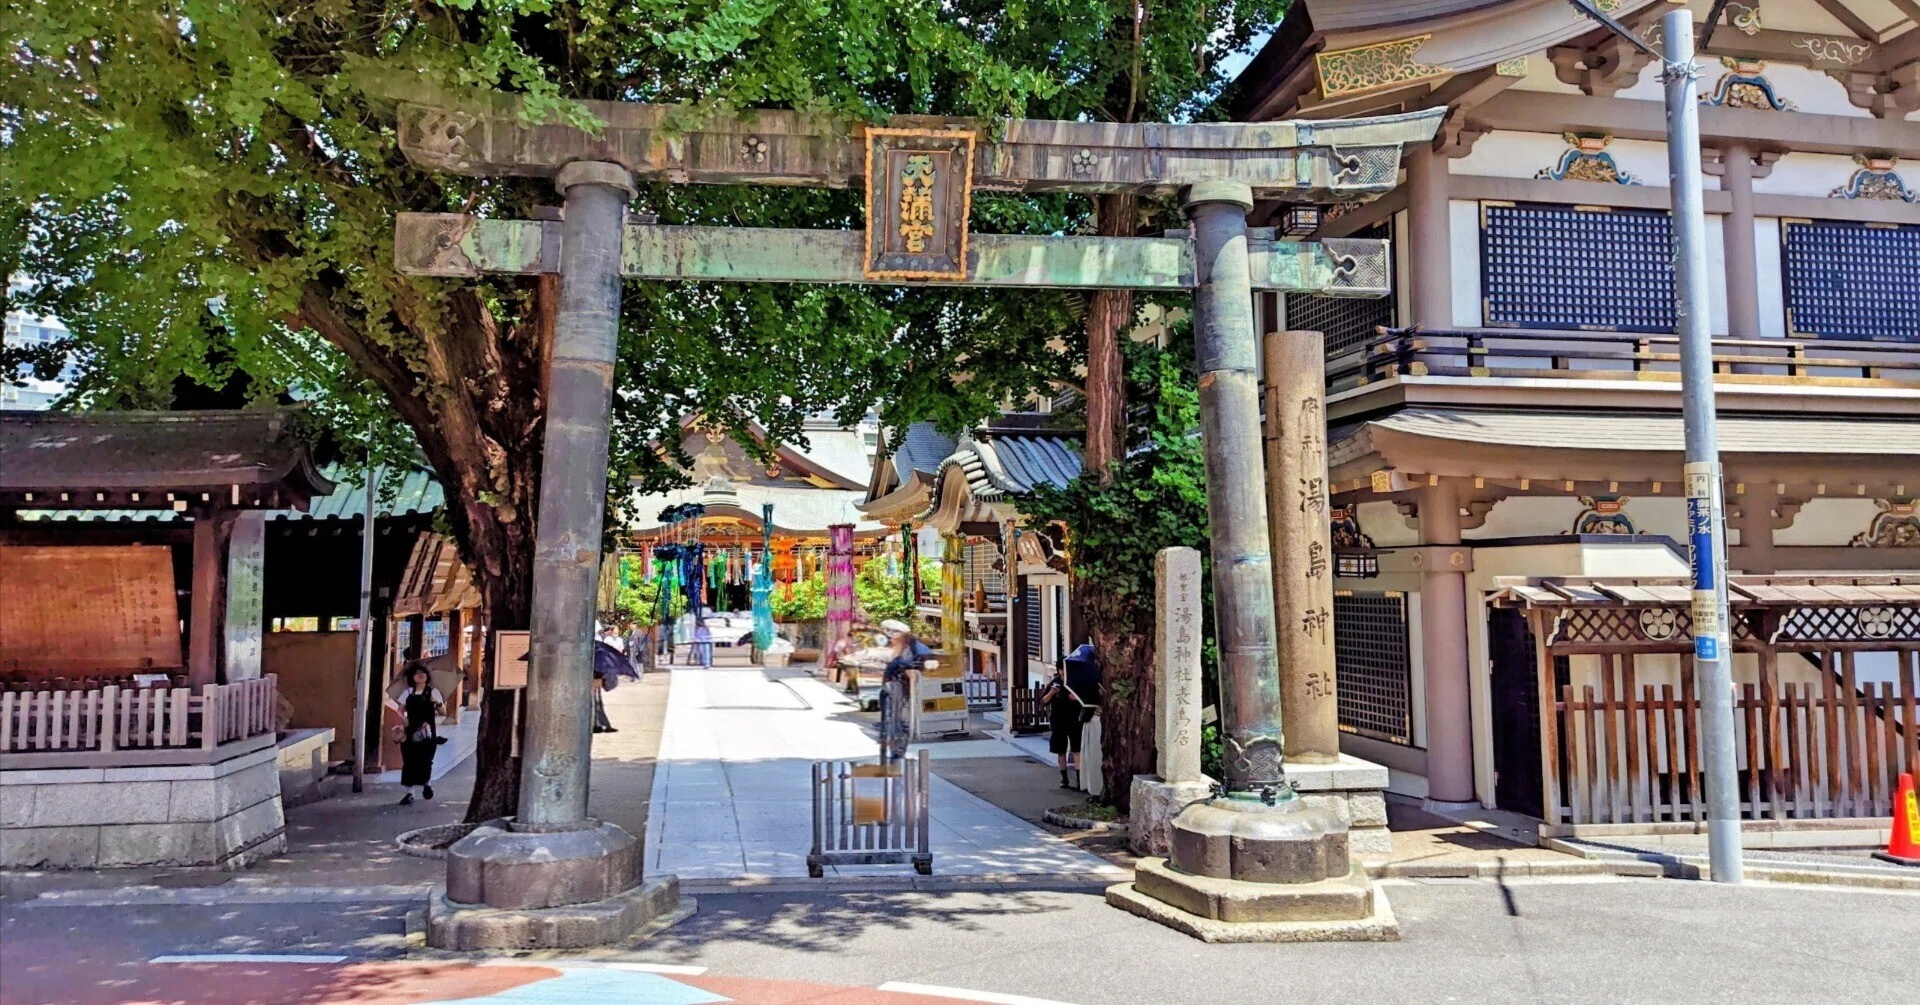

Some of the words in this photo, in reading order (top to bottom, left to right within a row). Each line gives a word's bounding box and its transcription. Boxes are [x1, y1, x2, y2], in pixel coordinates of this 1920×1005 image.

[1301, 396, 1321, 454] 府社
[1696, 499, 1711, 534] 御茶ノ水
[1299, 477, 1332, 701] 湯島神社
[1174, 606, 1193, 746] 湯島神社表鳥居
